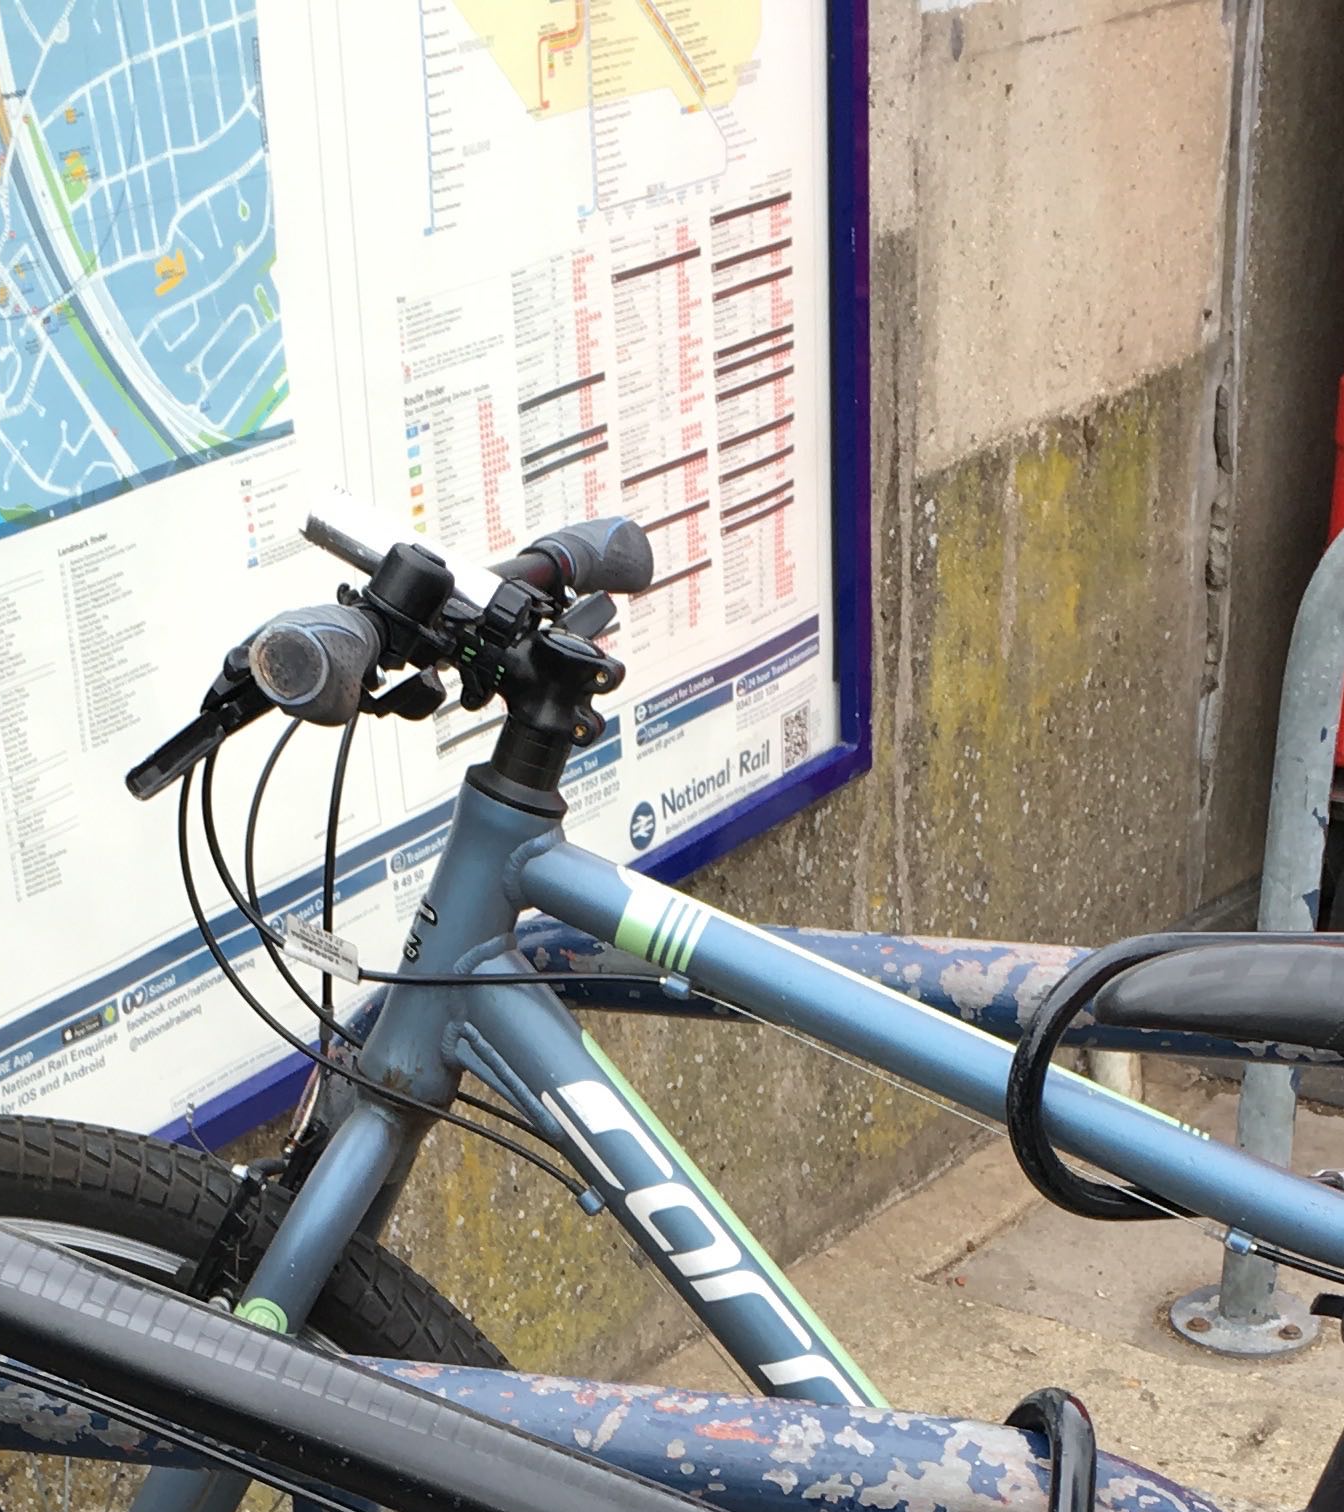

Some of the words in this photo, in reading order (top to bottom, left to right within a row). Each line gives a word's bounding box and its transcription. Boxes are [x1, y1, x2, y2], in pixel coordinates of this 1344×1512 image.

[661, 758, 730, 820] National
[739, 739, 770, 777] Rail
[149, 974, 177, 998] Social
[0, 1102, 15, 1116] for
[18, 1088, 37, 1108] iOS
[40, 1079, 60, 1097] and
[63, 1055, 106, 1086] Android
[1, 1065, 46, 1097] National
[48, 1054, 69, 1074] Rail
[71, 1032, 119, 1063] Enquiries
[13, 1050, 34, 1069] App
